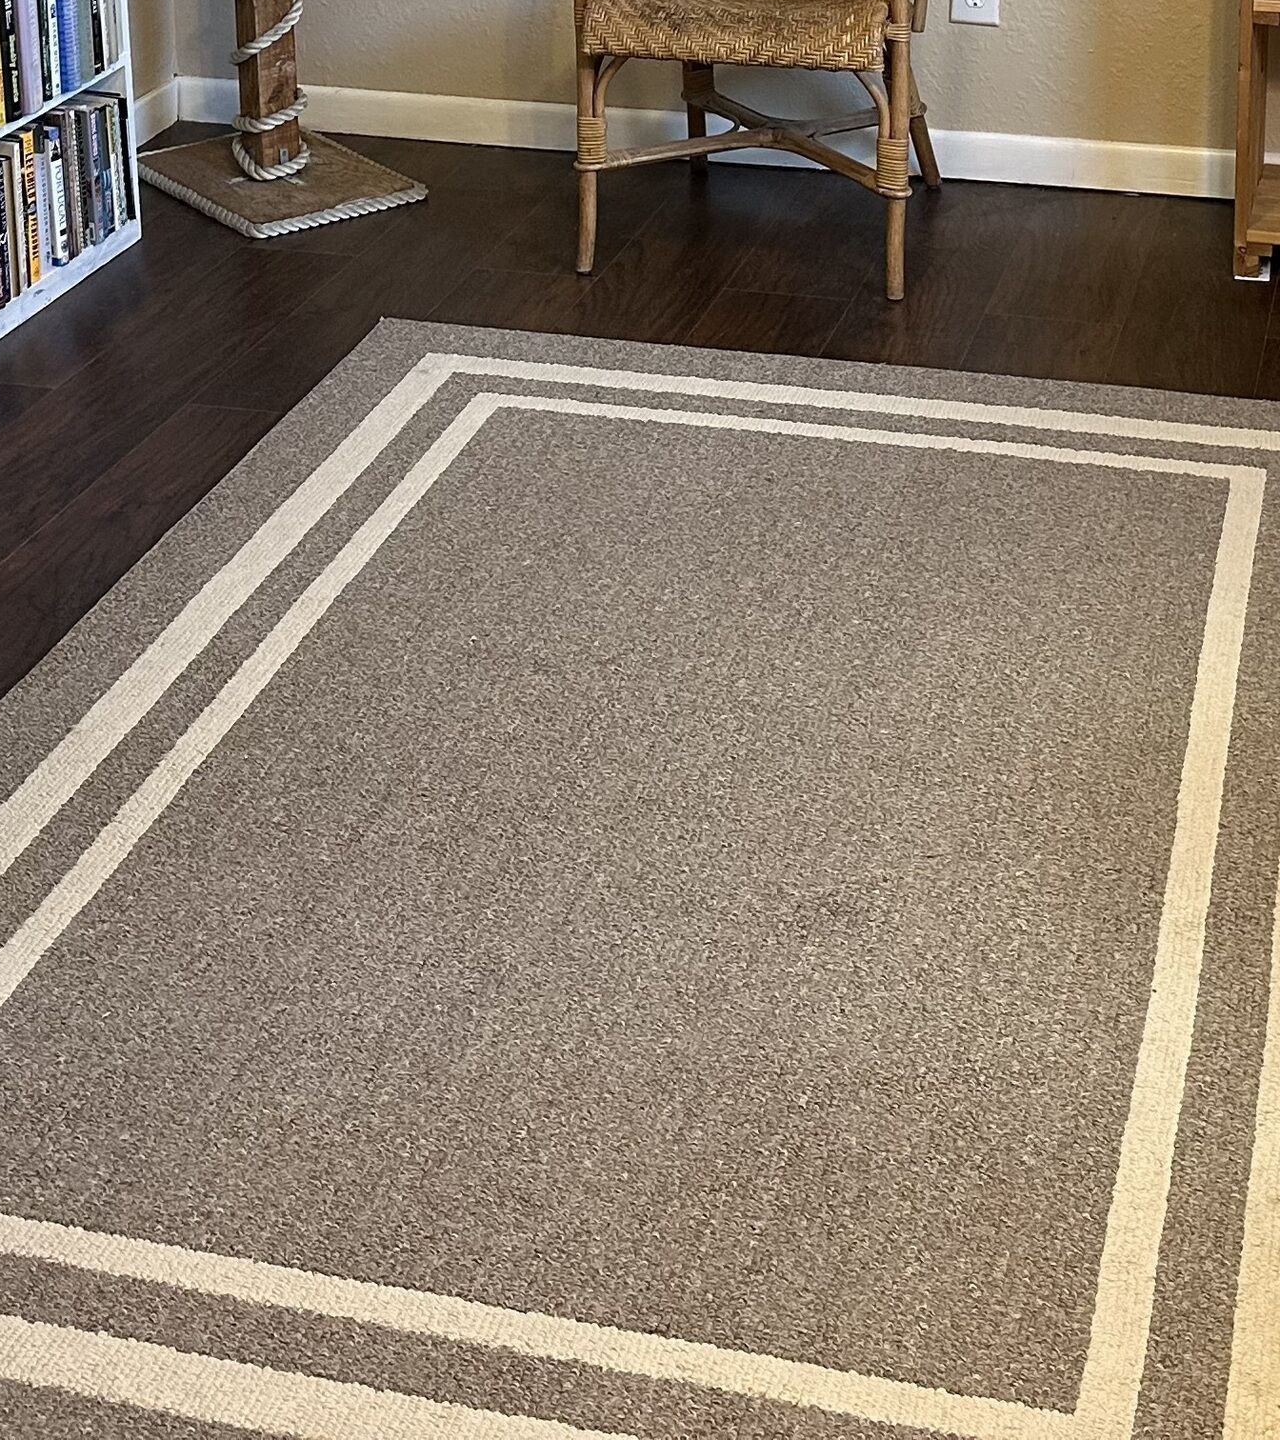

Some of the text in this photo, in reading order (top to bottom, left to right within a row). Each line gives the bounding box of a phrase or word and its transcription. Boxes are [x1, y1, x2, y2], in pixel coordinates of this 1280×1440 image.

[8, 34, 18, 67] Deadly
[11, 70, 20, 102] Assets
[25, 153, 40, 261] LEE CHILD PERSONAL
[54, 165, 67, 227] PORTUGAL
